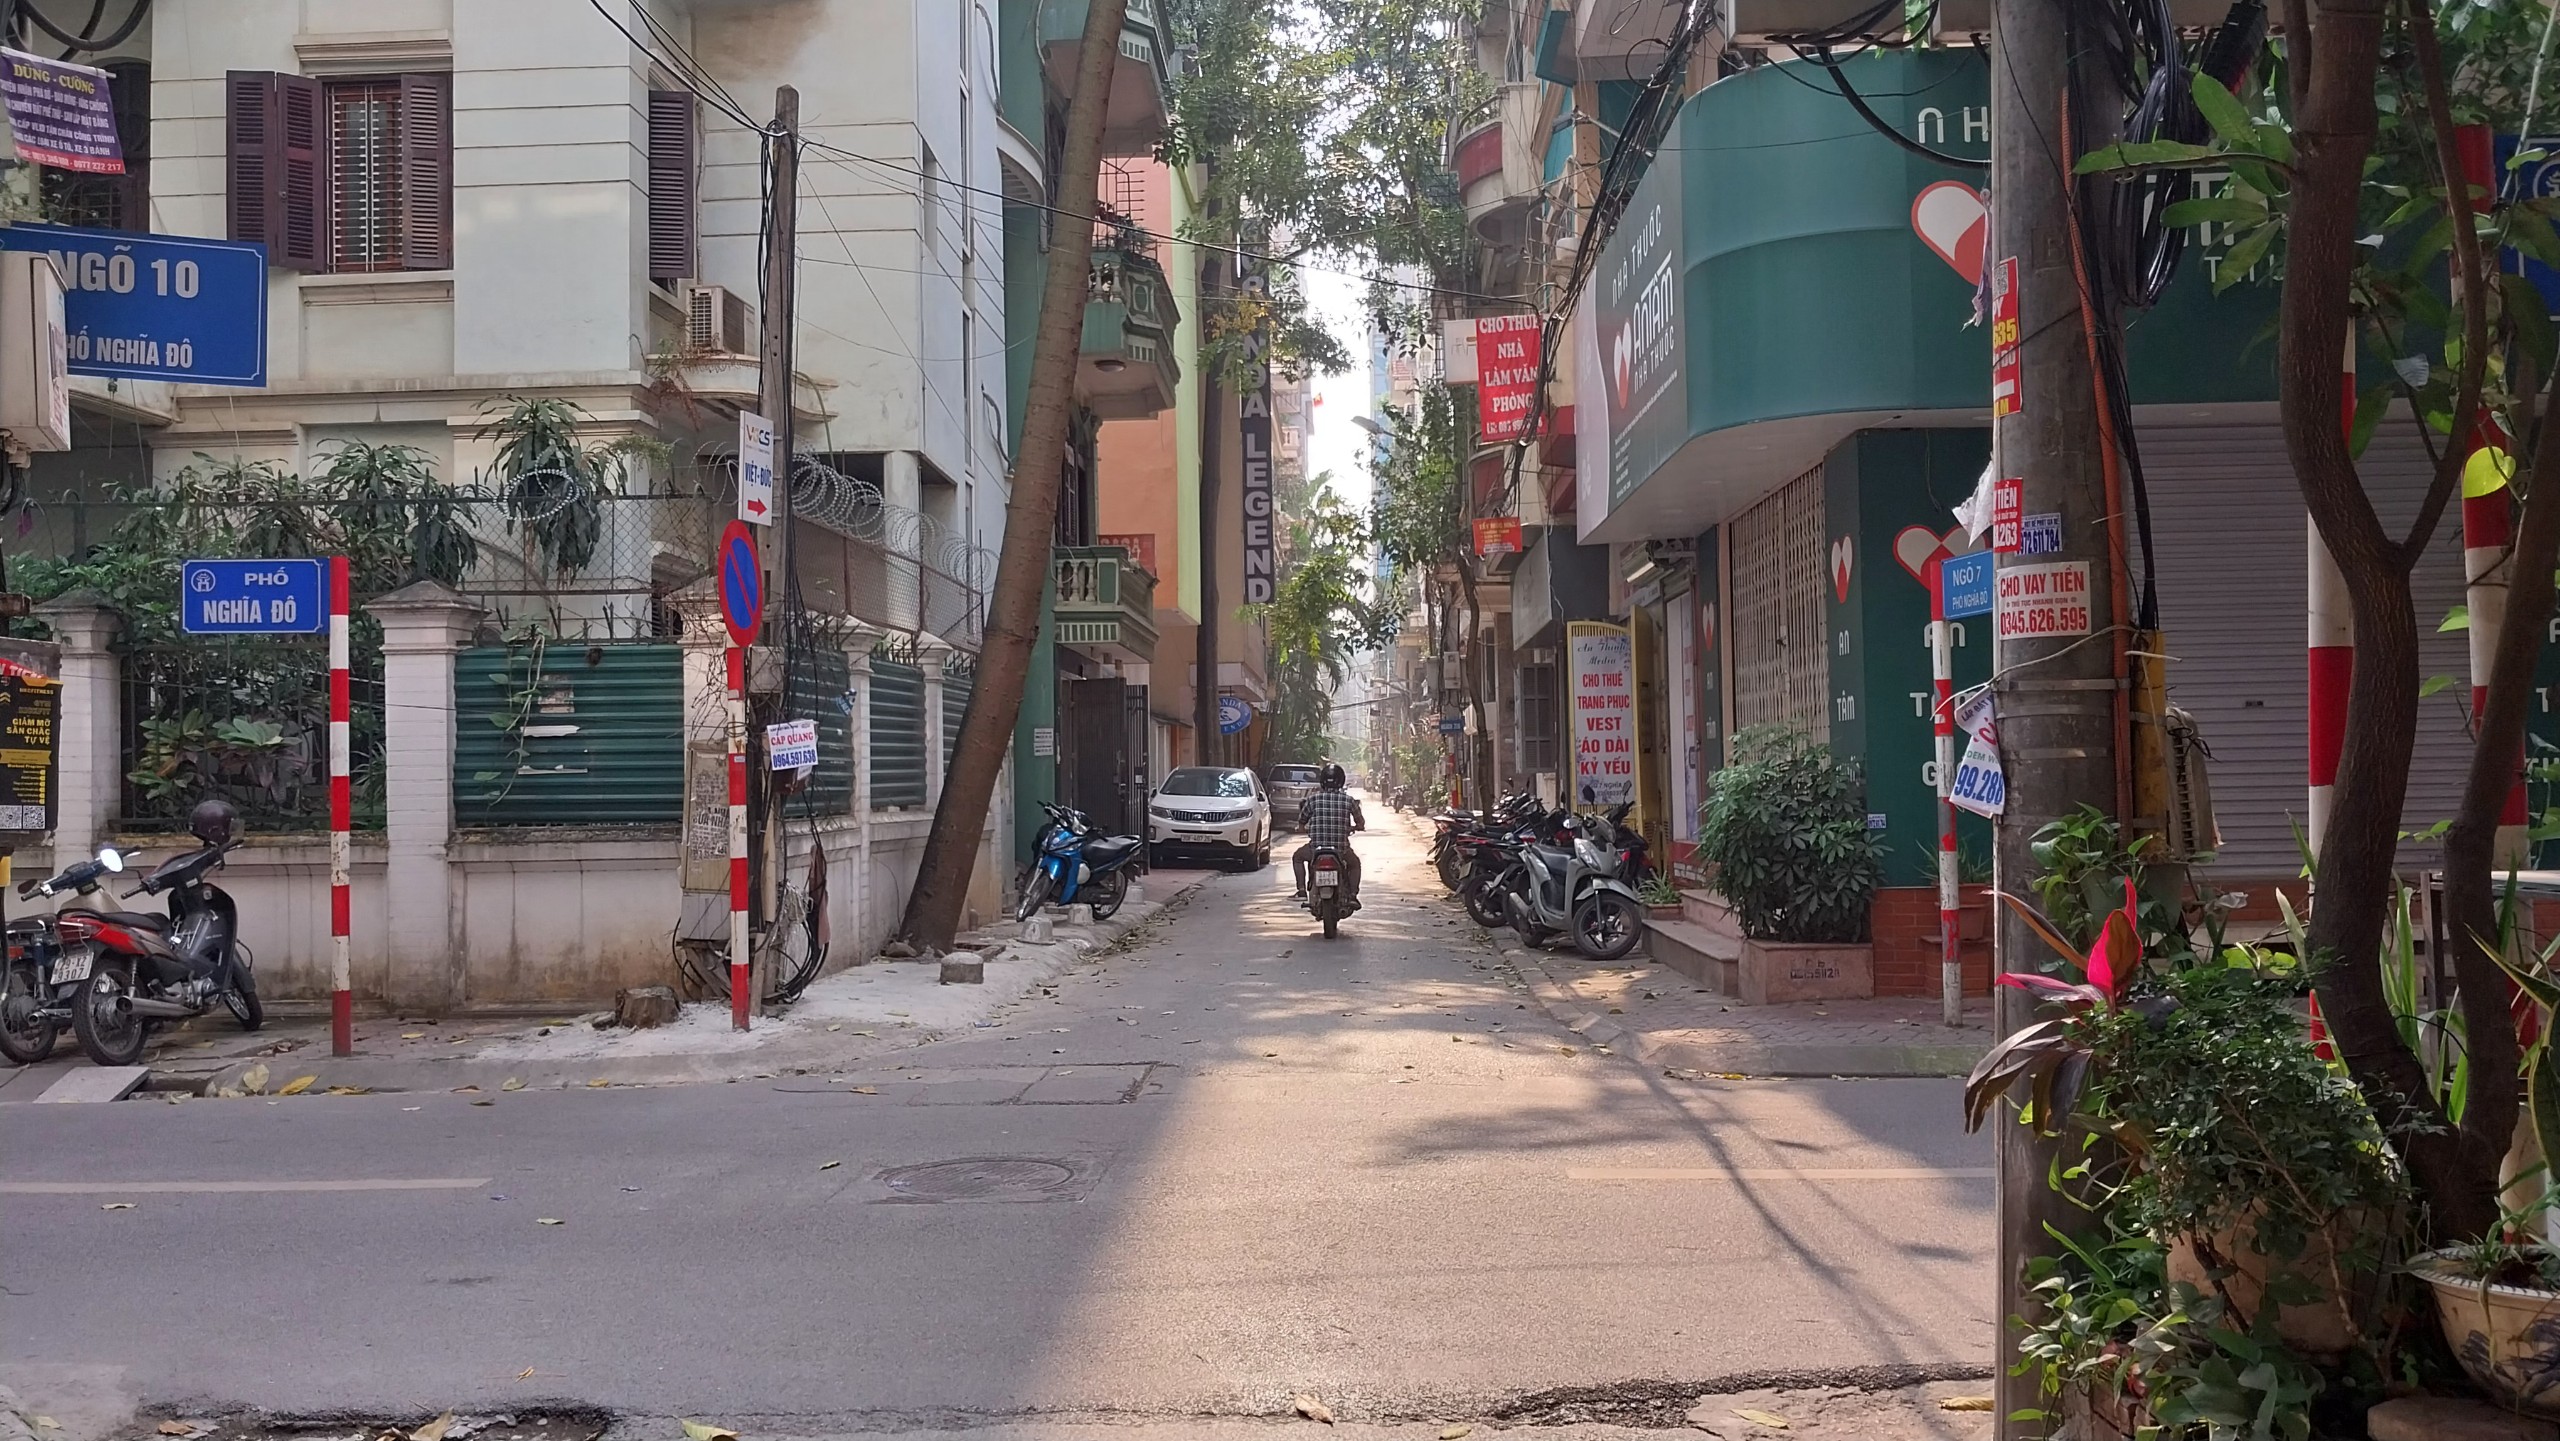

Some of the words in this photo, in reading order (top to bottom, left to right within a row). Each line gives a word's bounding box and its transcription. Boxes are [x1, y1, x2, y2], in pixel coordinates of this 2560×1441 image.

[13, 63, 51, 83] DŨNG
[59, 75, 95, 94] CƯỜNG
[1918, 106, 1989, 144] NH
[1631, 204, 1662, 276] THUỐC
[49, 245, 135, 294] NGÕ
[151, 259, 199, 298] 10
[1479, 317, 1504, 334] CHO
[66, 325, 90, 361] HỐ
[97, 334, 160, 366] NGHĨA
[165, 338, 193, 369] ĐÔ
[1498, 338, 1525, 359] NHÀ
[1485, 366, 1511, 387] LÀM
[1244, 433, 1272, 604] LEGEND
[244, 566, 290, 586] PHỐ
[1952, 562, 1974, 587] NGÕ
[1976, 565, 1982, 582] 7
[2000, 575, 2019, 598] CHO
[2024, 573, 2047, 595] VAY
[2051, 565, 2085, 593] TIỀN
[203, 595, 262, 624] NGHĨA
[271, 595, 296, 624] ĐÔ
[2000, 607, 2087, 635] 0345.626.595
[1582, 673, 1599, 688] CHO
[1602, 670, 1623, 687] THUÊ
[1577, 695, 1605, 710] TRANG
[1607, 694, 1630, 712] PHỤC
[1837, 689, 1855, 722] TÂM
[1586, 717, 1622, 731] VEST
[788, 732, 814, 745] QUANG
[1581, 735, 1600, 753] ÁO
[1605, 735, 1629, 753] DÀI
[1580, 756, 1599, 775] KỶ
[1603, 756, 1631, 775] YẾU
